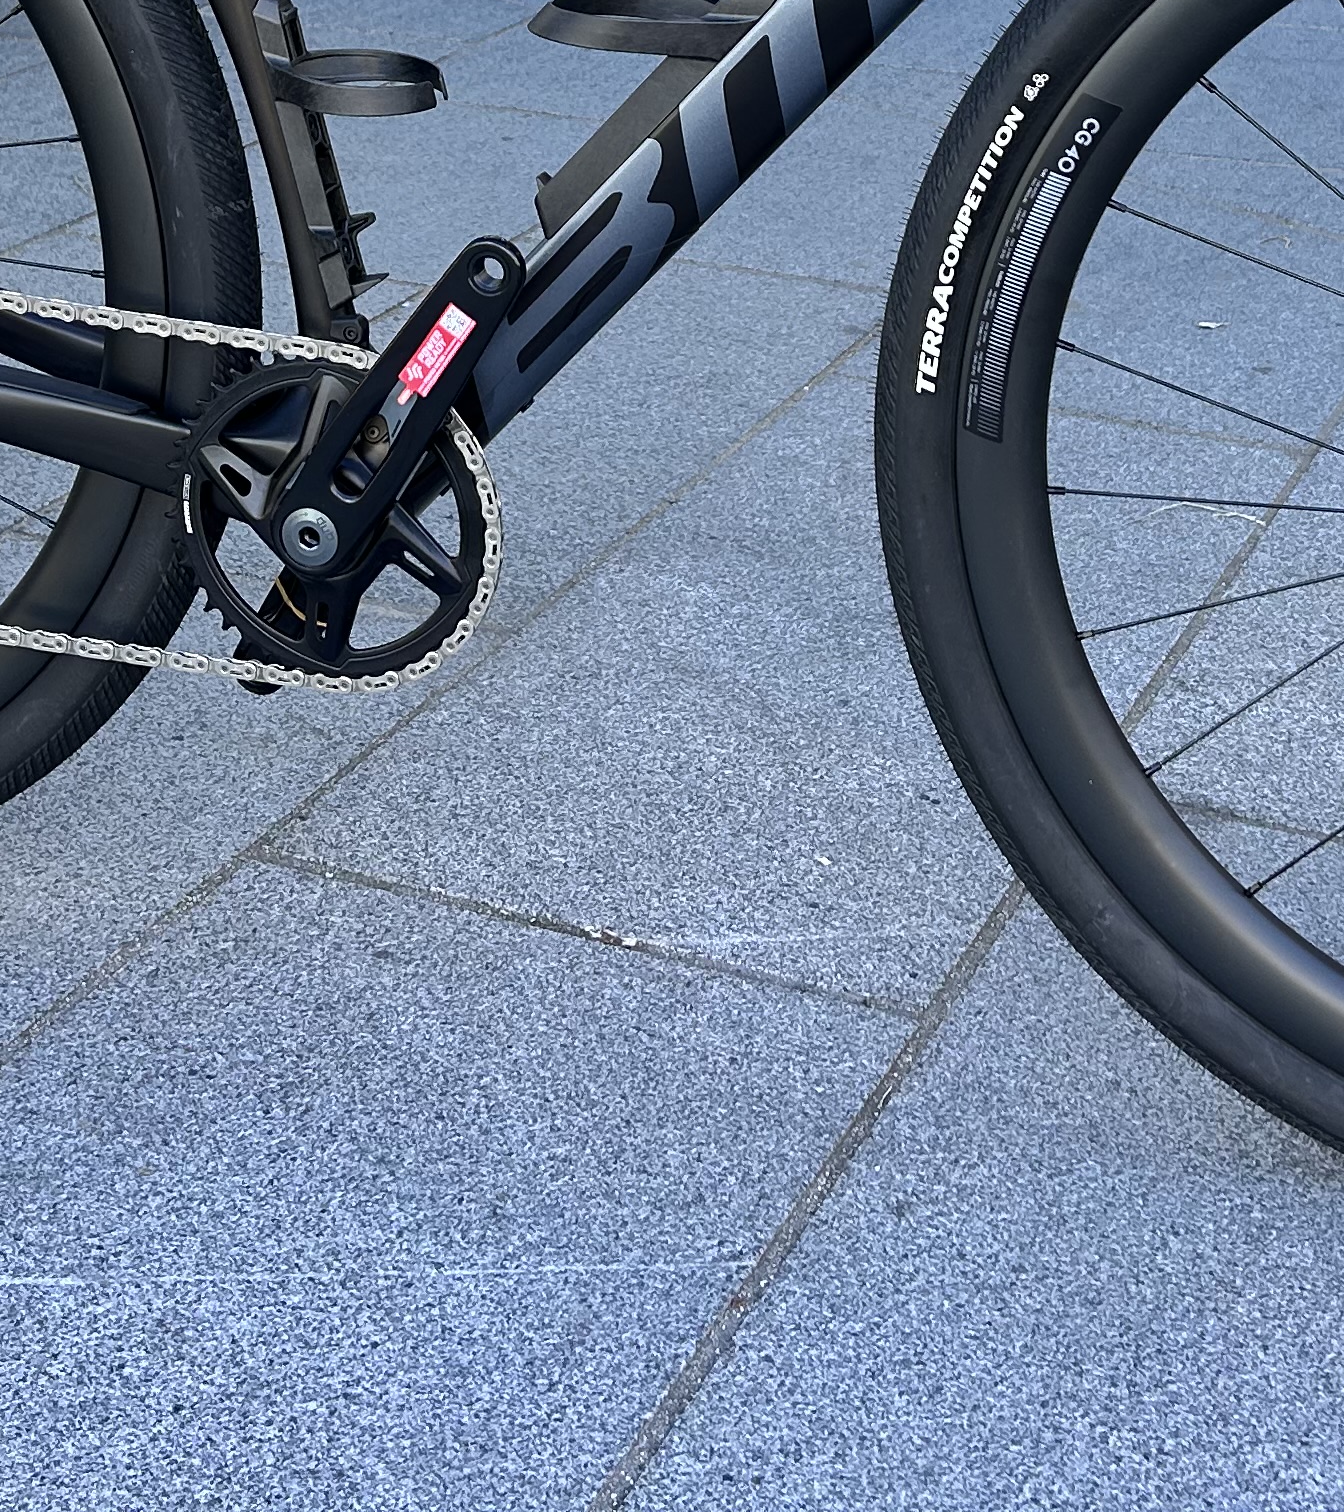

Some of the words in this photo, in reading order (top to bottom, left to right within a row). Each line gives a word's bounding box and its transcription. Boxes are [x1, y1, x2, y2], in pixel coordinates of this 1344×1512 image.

[1074, 117, 1101, 146] CG
[1058, 143, 1080, 173] 40
[915, 105, 1025, 395] TERRACOMPETITION
[417, 330, 443, 363] POWER
[424, 338, 446, 368] READY
